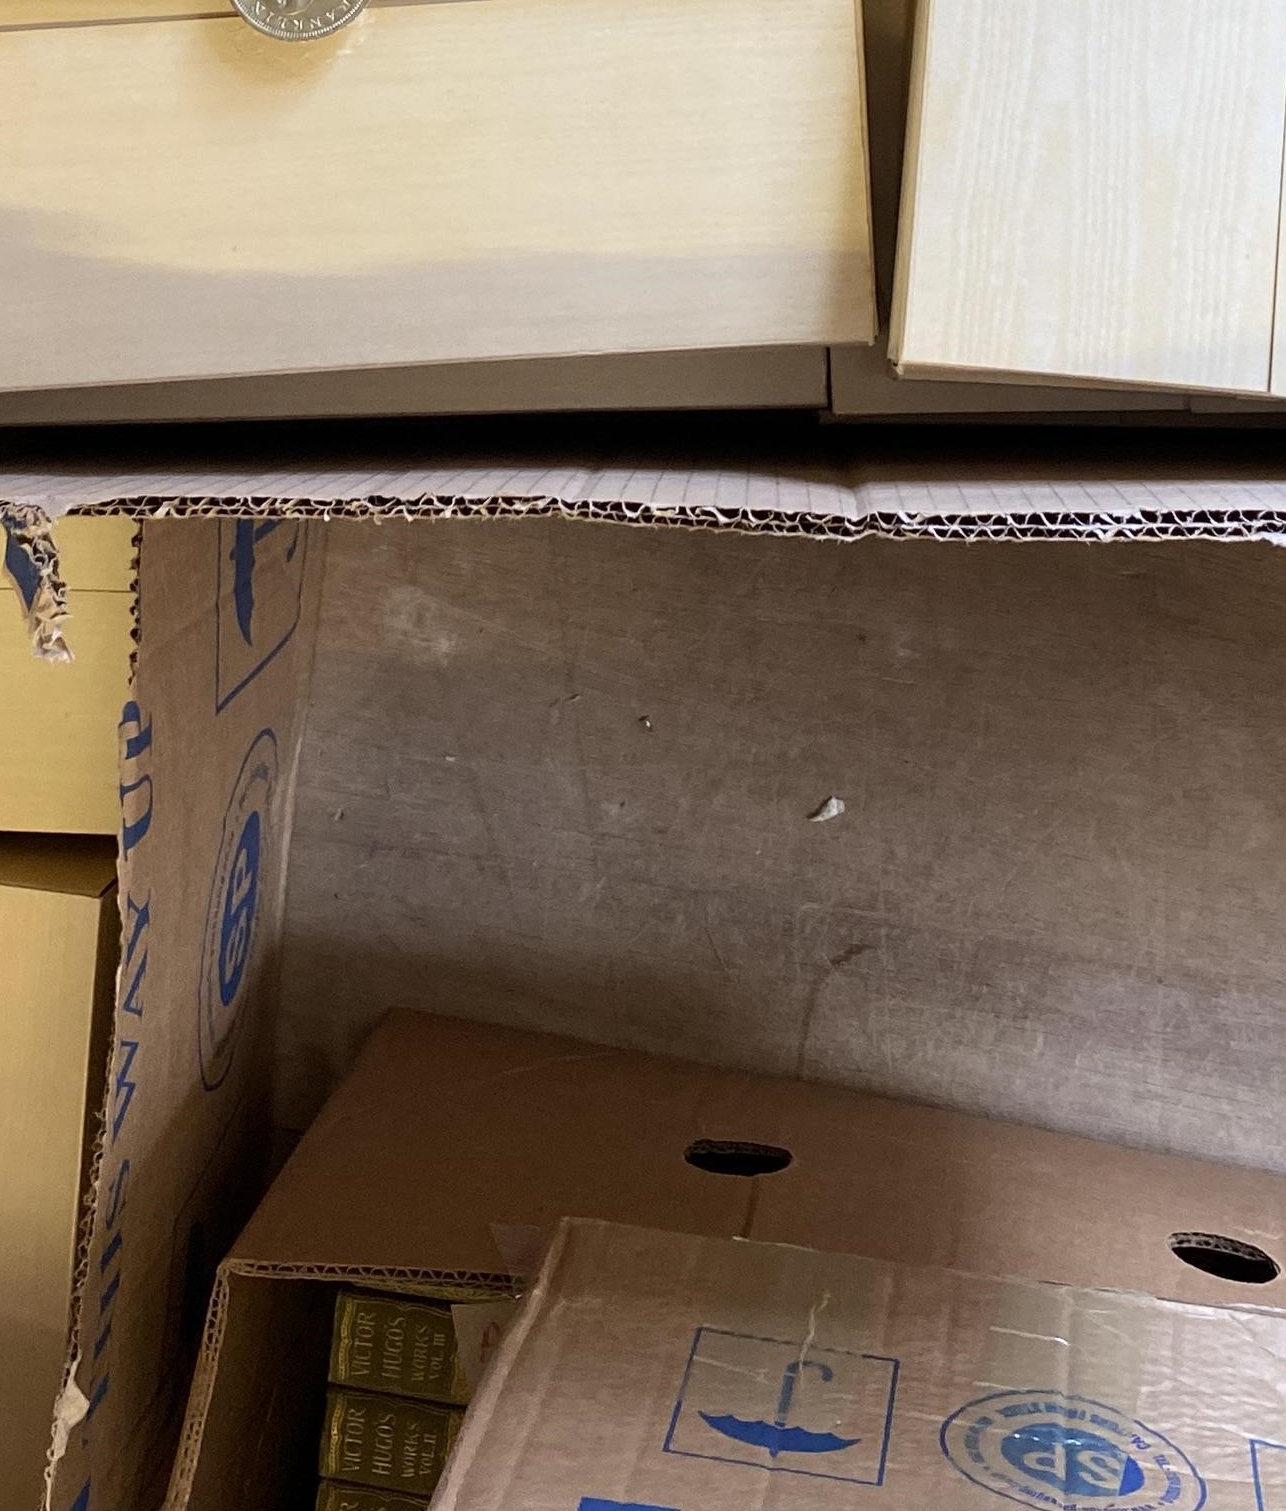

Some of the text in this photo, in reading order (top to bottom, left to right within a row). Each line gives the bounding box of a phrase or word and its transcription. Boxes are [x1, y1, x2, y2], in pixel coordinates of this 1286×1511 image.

[118, 699, 154, 862] UP
[352, 1311, 377, 1377] VICTOR
[381, 1316, 406, 1379] HUGO'S
[411, 1323, 431, 1381] WORKS
[342, 1407, 366, 1472] VICTOR
[371, 1413, 396, 1475] HUGO'S
[401, 1422, 420, 1478] WORKS
[1022, 1442, 1121, 1490] SP
